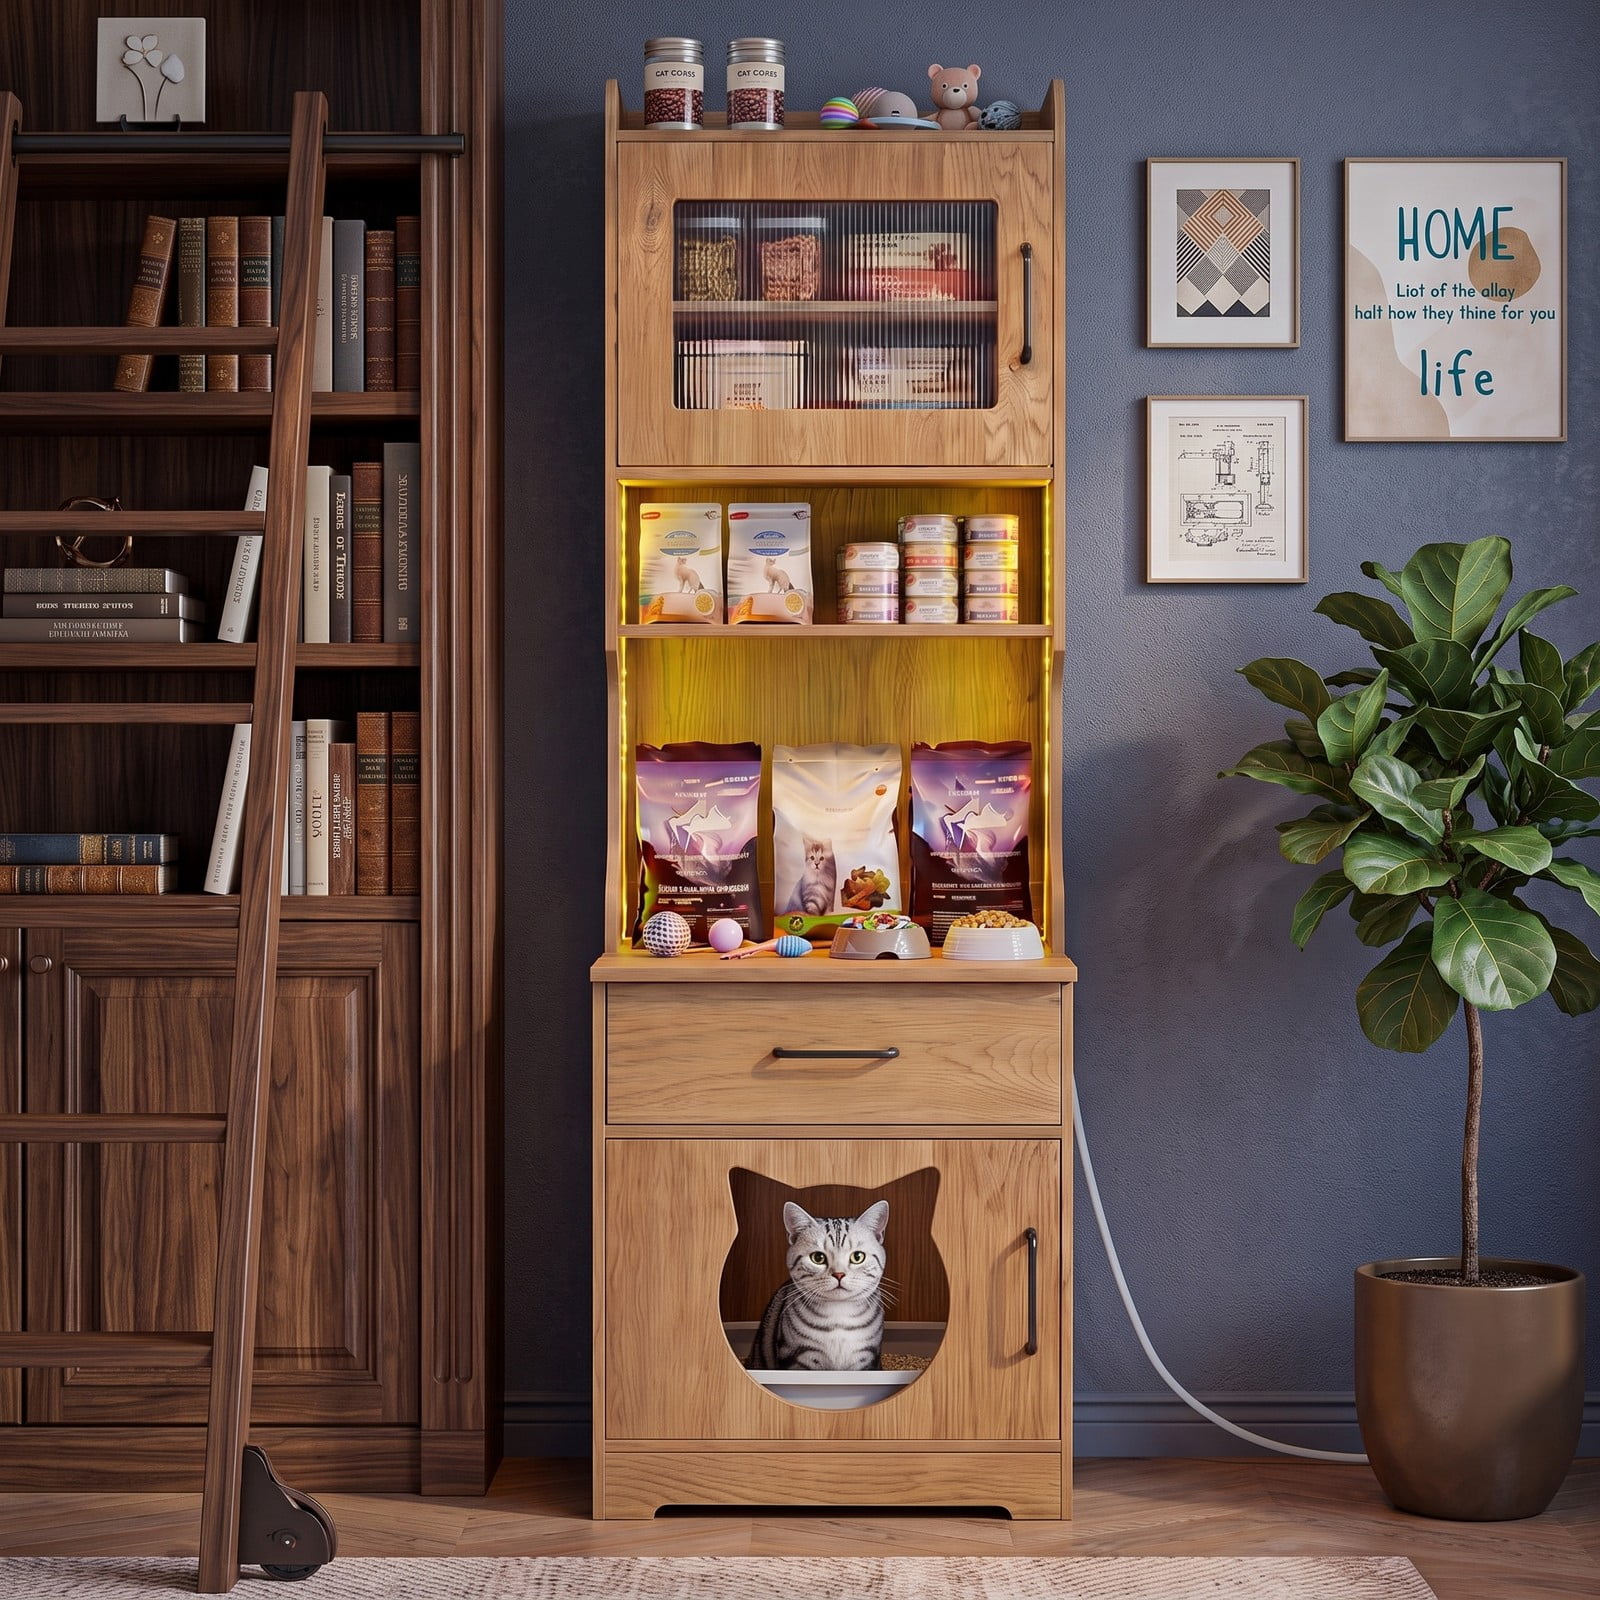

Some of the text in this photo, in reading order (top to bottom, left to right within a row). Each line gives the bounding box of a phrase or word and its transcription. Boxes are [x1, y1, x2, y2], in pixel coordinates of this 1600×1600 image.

[655, 69, 669, 78] CAT
[737, 69, 778, 78] CAT CORES
[1398, 205, 1516, 262] HOME
[1396, 282, 1516, 303] Liot of the allay
[1354, 305, 1556, 325] halt how they thine for you
[1420, 348, 1495, 397] life
